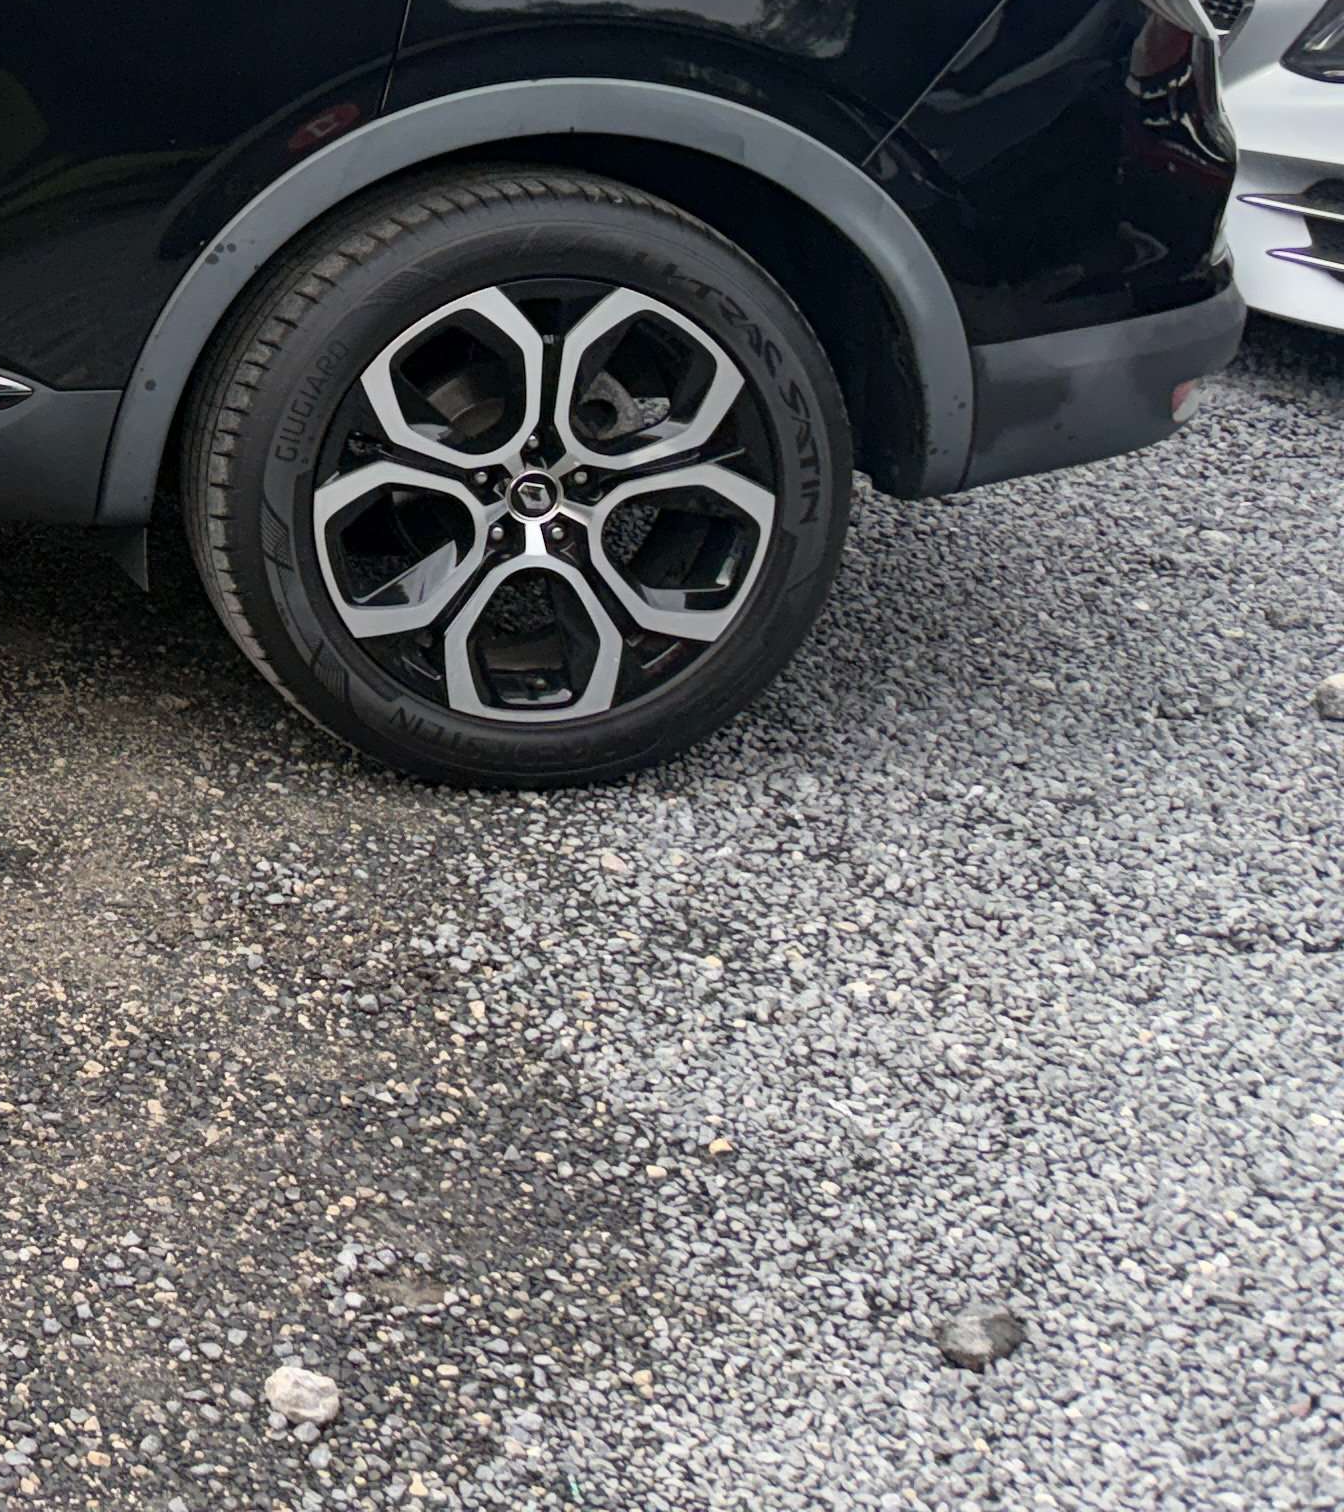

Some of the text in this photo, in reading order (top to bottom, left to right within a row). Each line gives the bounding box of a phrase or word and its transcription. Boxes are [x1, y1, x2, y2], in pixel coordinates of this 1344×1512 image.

[275, 339, 351, 463] GIUGIARO
[632, 251, 822, 526] LTRAC SATIN
[388, 706, 617, 768] REDSTEIN
